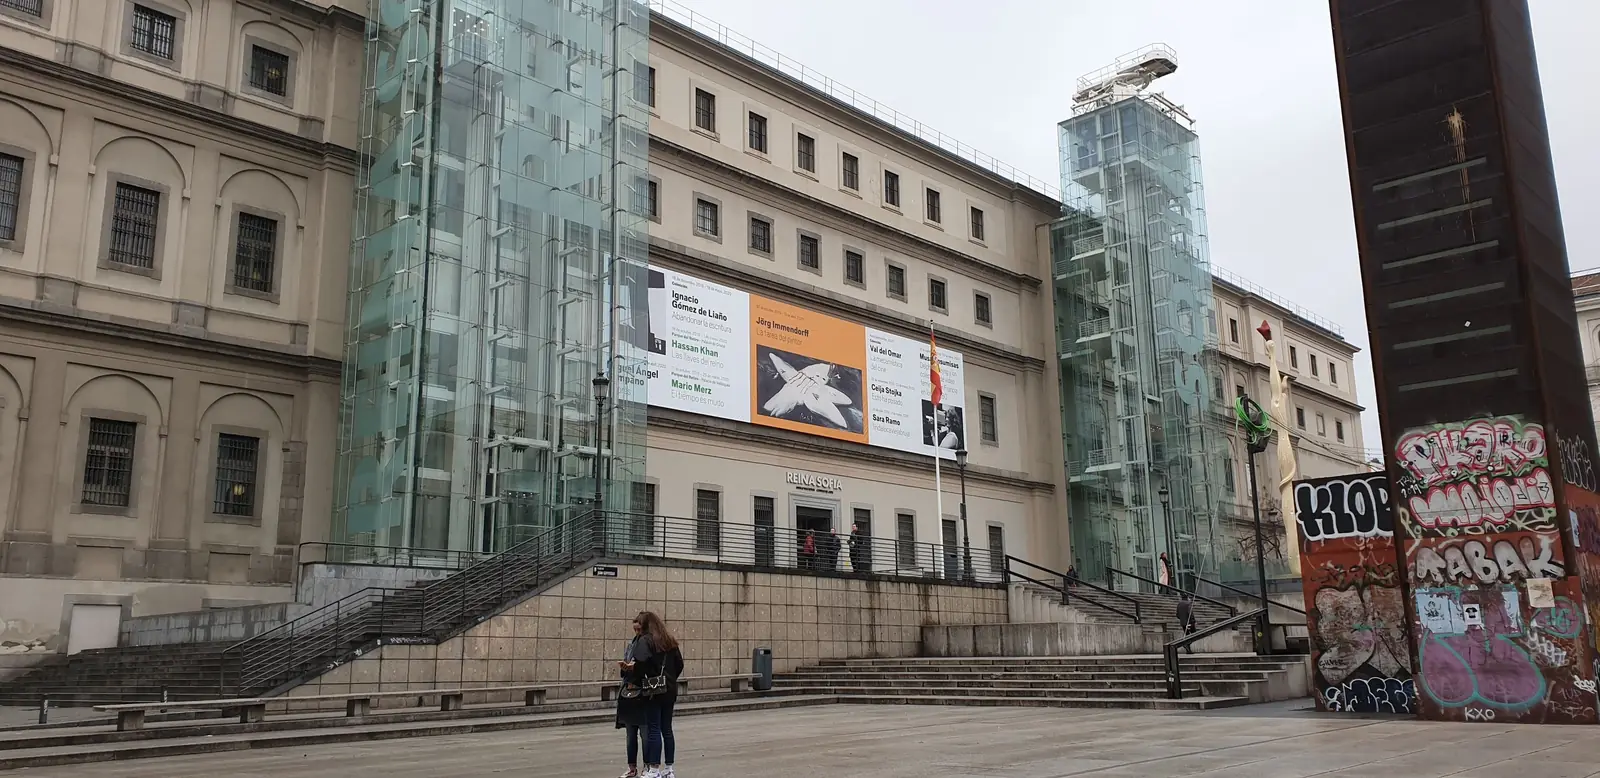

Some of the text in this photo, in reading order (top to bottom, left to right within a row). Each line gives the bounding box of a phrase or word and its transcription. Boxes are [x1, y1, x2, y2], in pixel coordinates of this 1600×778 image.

[672, 290, 699, 304] Ignacio
[672, 300, 727, 321] Gómez de Liaño
[756, 317, 809, 337] Jörg Immendorff
[672, 340, 719, 357] Hassan Khan
[870, 345, 902, 359] Val del Omar
[636, 365, 659, 379] Ángel
[672, 379, 712, 395] Mario Merz
[886, 387, 902, 397] Stojka
[873, 414, 900, 426] Sara Ramo
[787, 471, 815, 486] REINA
[1464, 706, 1496, 721] KXO
